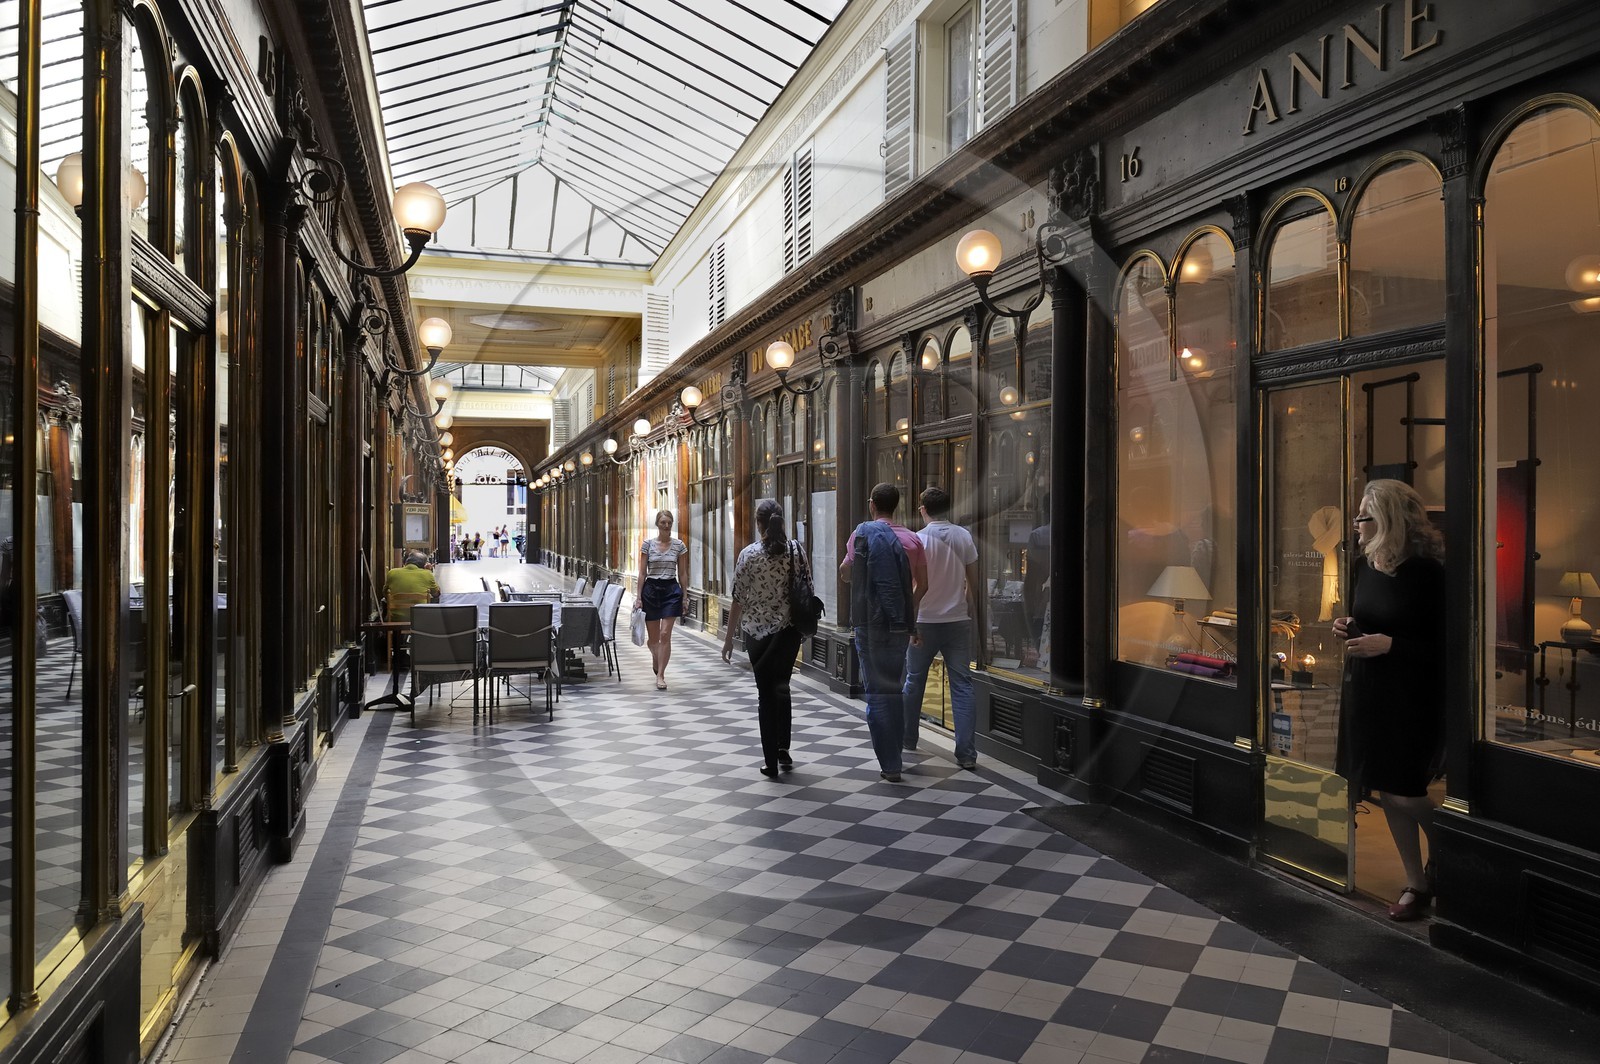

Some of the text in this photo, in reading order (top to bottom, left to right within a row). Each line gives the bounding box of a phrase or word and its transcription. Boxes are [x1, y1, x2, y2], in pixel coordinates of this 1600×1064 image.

[1242, 0, 1444, 136] ANNE
[1119, 146, 1142, 183] 16
[1334, 176, 1347, 194] 16
[752, 347, 764, 374] DU
